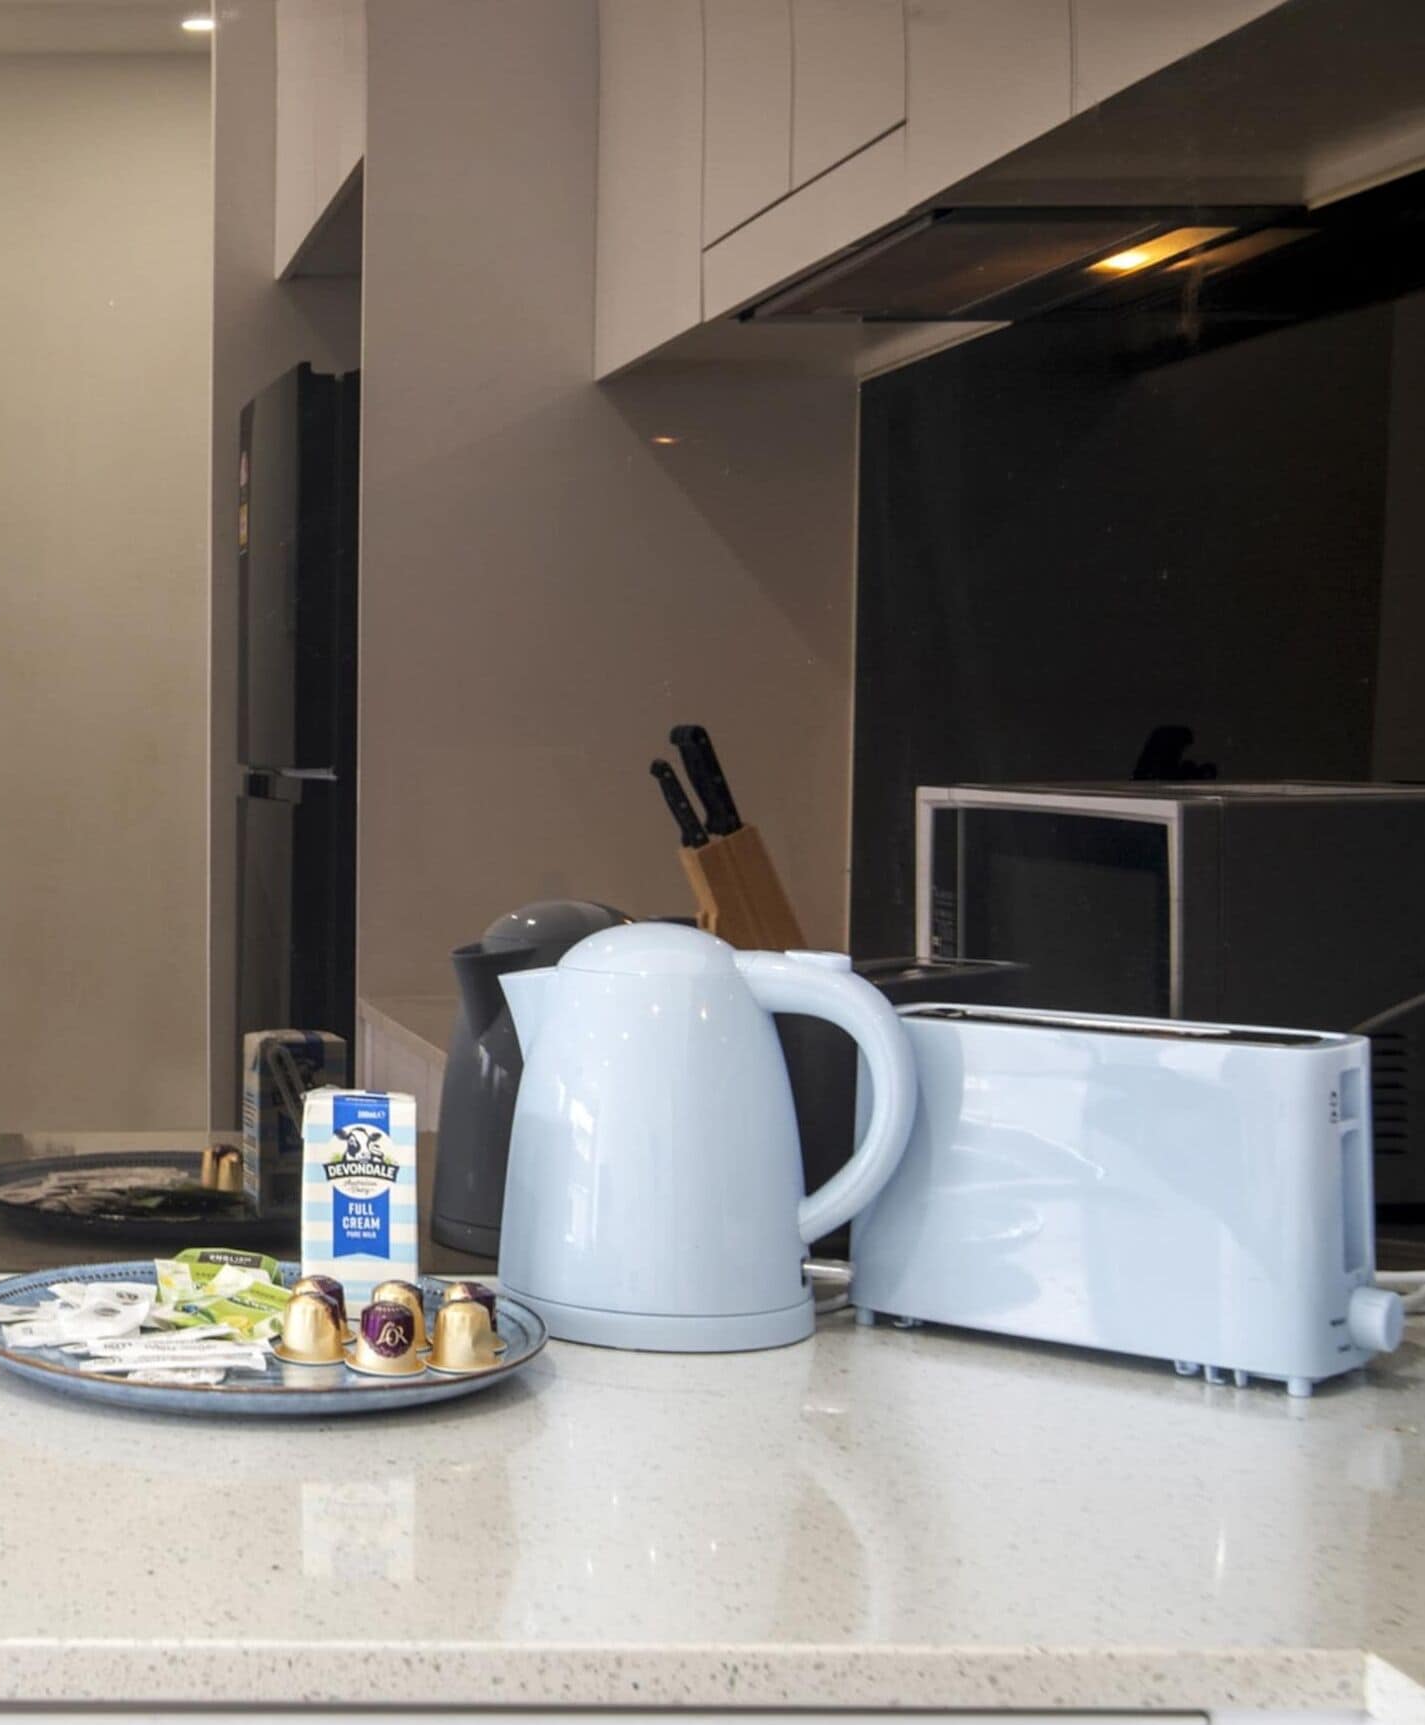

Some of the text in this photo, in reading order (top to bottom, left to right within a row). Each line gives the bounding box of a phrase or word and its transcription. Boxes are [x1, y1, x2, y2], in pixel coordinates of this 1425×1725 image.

[327, 1163, 395, 1179] DEVONDALE
[348, 1202, 374, 1216] FULL
[342, 1216, 381, 1231] CREAM
